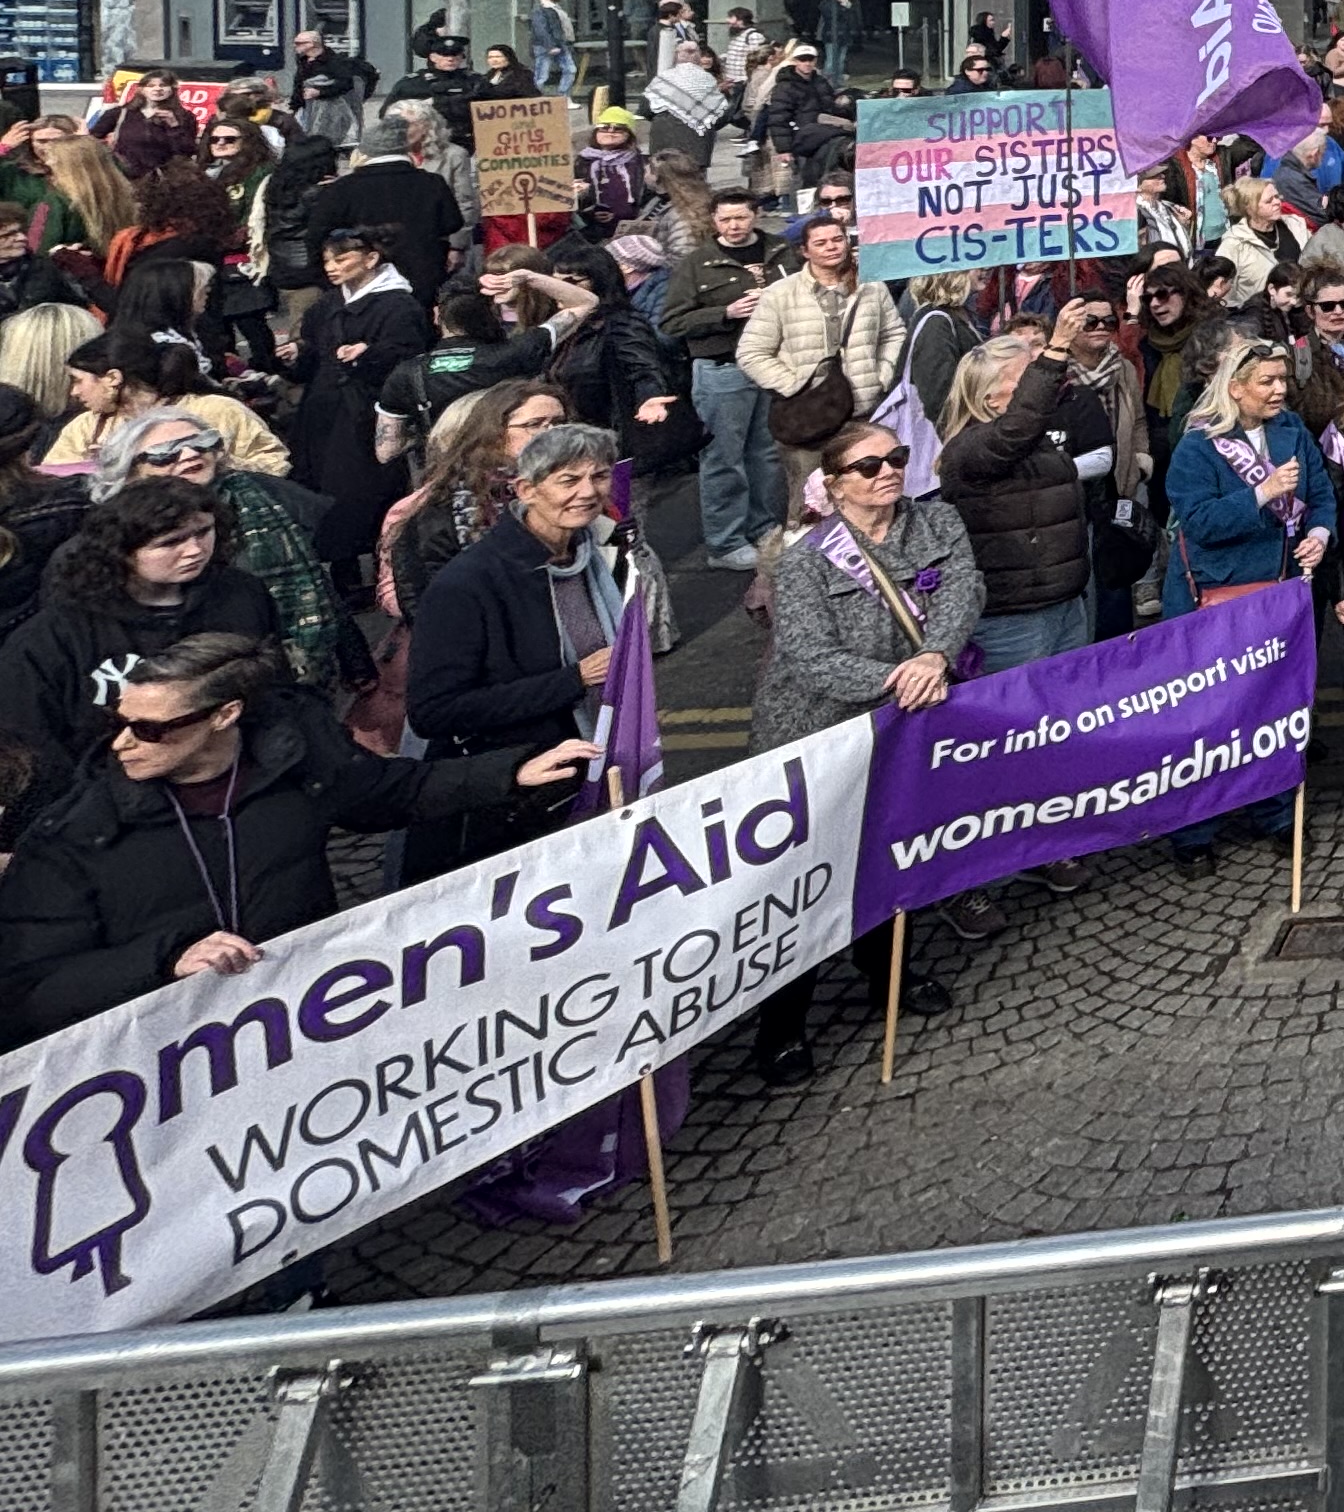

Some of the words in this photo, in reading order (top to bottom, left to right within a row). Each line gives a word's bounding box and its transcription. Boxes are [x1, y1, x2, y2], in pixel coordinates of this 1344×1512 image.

[476, 101, 552, 121] WOMEN
[924, 100, 1074, 143] SUPPORT
[891, 148, 953, 183] OUR
[975, 134, 1116, 178] SISTERS
[917, 179, 992, 217] NOT
[1010, 165, 1112, 211] JUST
[914, 211, 1120, 265] CIS-TERS
[931, 738, 998, 770] For
[1003, 715, 1071, 755] info
[1076, 703, 1115, 734] on
[1117, 657, 1228, 720] support
[1230, 637, 1288, 676] visit:
[890, 705, 1311, 871] womensaidni.org
[0, 871, 584, 1295] omen's
[607, 755, 809, 933] Aid
[206, 971, 621, 1193] WORKING
[634, 929, 720, 996] TO
[732, 861, 834, 954] END
[227, 1028, 599, 1267] DOMESTIC
[614, 923, 801, 1065] ABUSE
